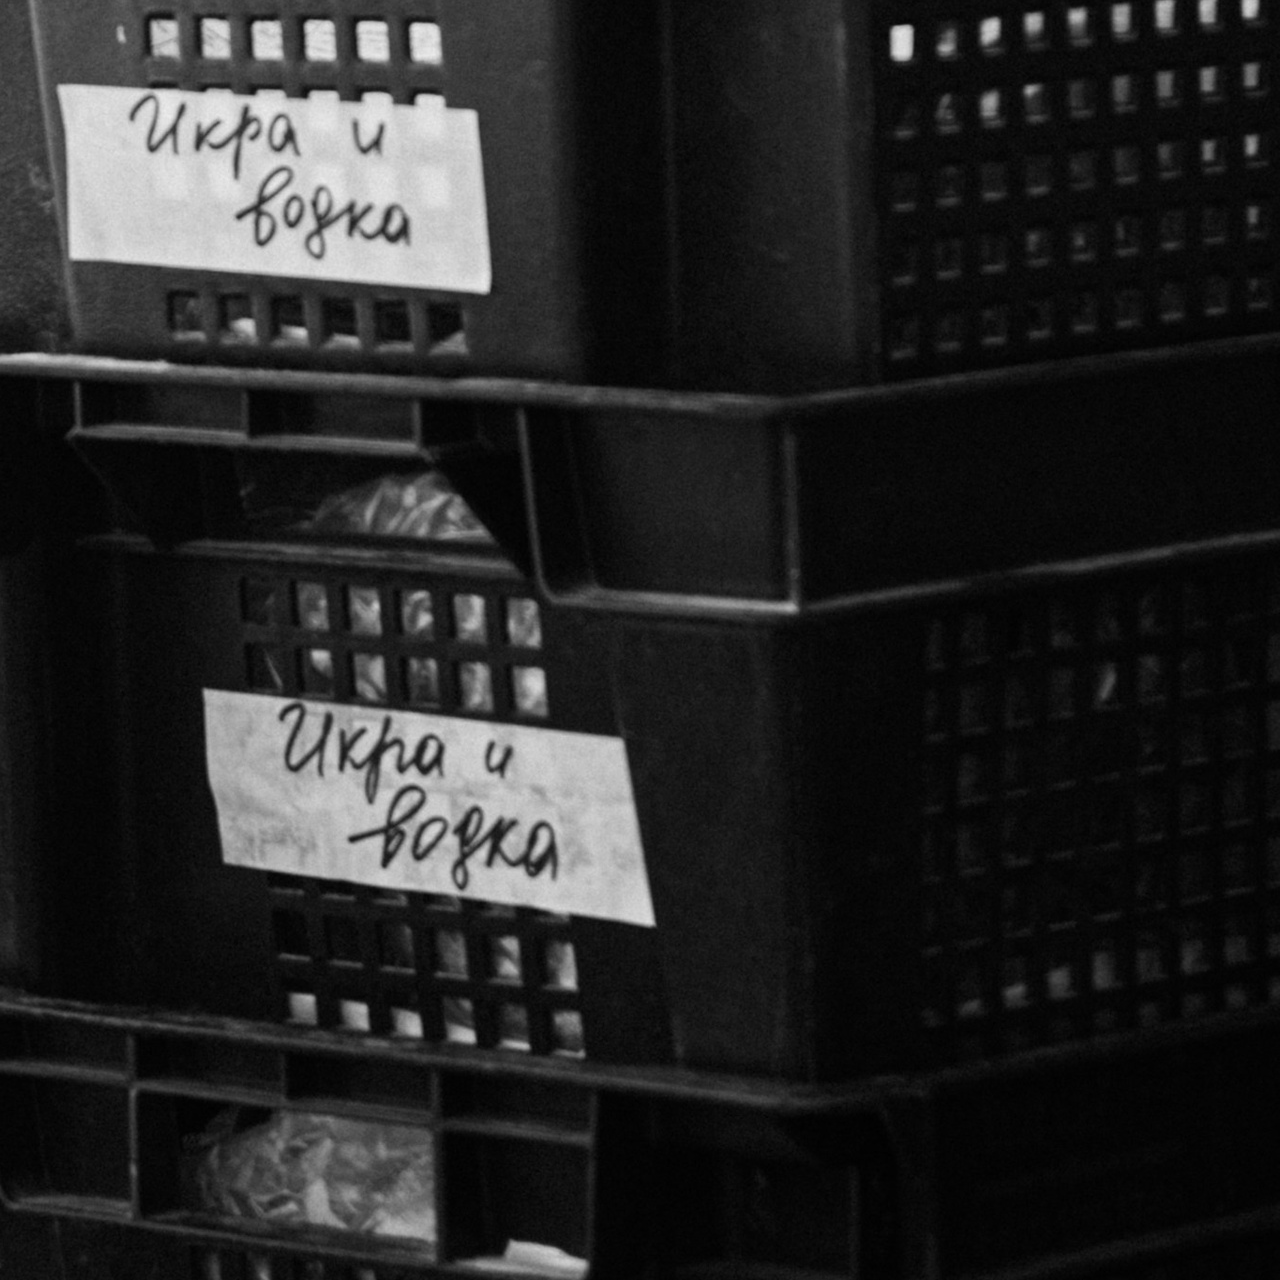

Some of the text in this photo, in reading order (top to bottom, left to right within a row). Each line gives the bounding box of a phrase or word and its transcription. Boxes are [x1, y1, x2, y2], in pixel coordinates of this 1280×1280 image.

[129, 94, 384, 180] Икра и
[236, 166, 411, 259] водка
[278, 703, 513, 804] Икра и
[348, 784, 558, 890] водка
